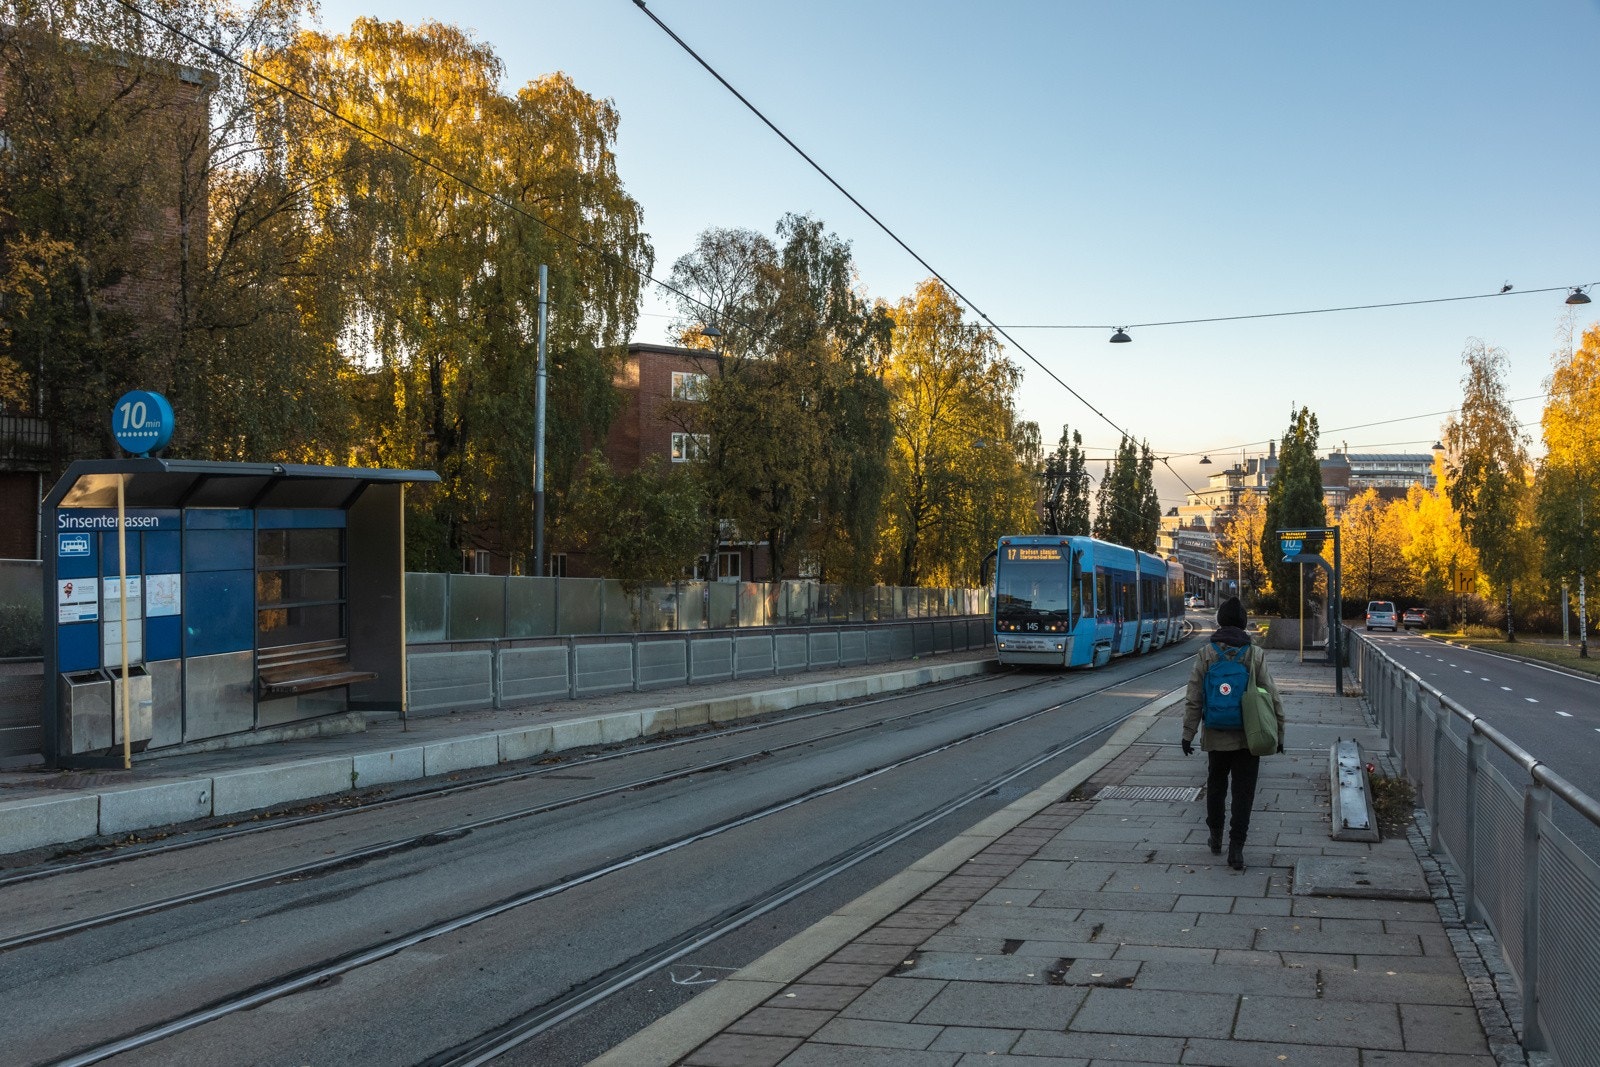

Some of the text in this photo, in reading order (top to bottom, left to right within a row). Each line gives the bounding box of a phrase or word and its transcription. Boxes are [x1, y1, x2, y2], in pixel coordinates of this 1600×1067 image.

[120, 401, 160, 429] 10 min
[58, 513, 159, 528] Sinsenterassen
[1008, 549, 1017, 560] 17
[1026, 622, 1039, 630] 145
